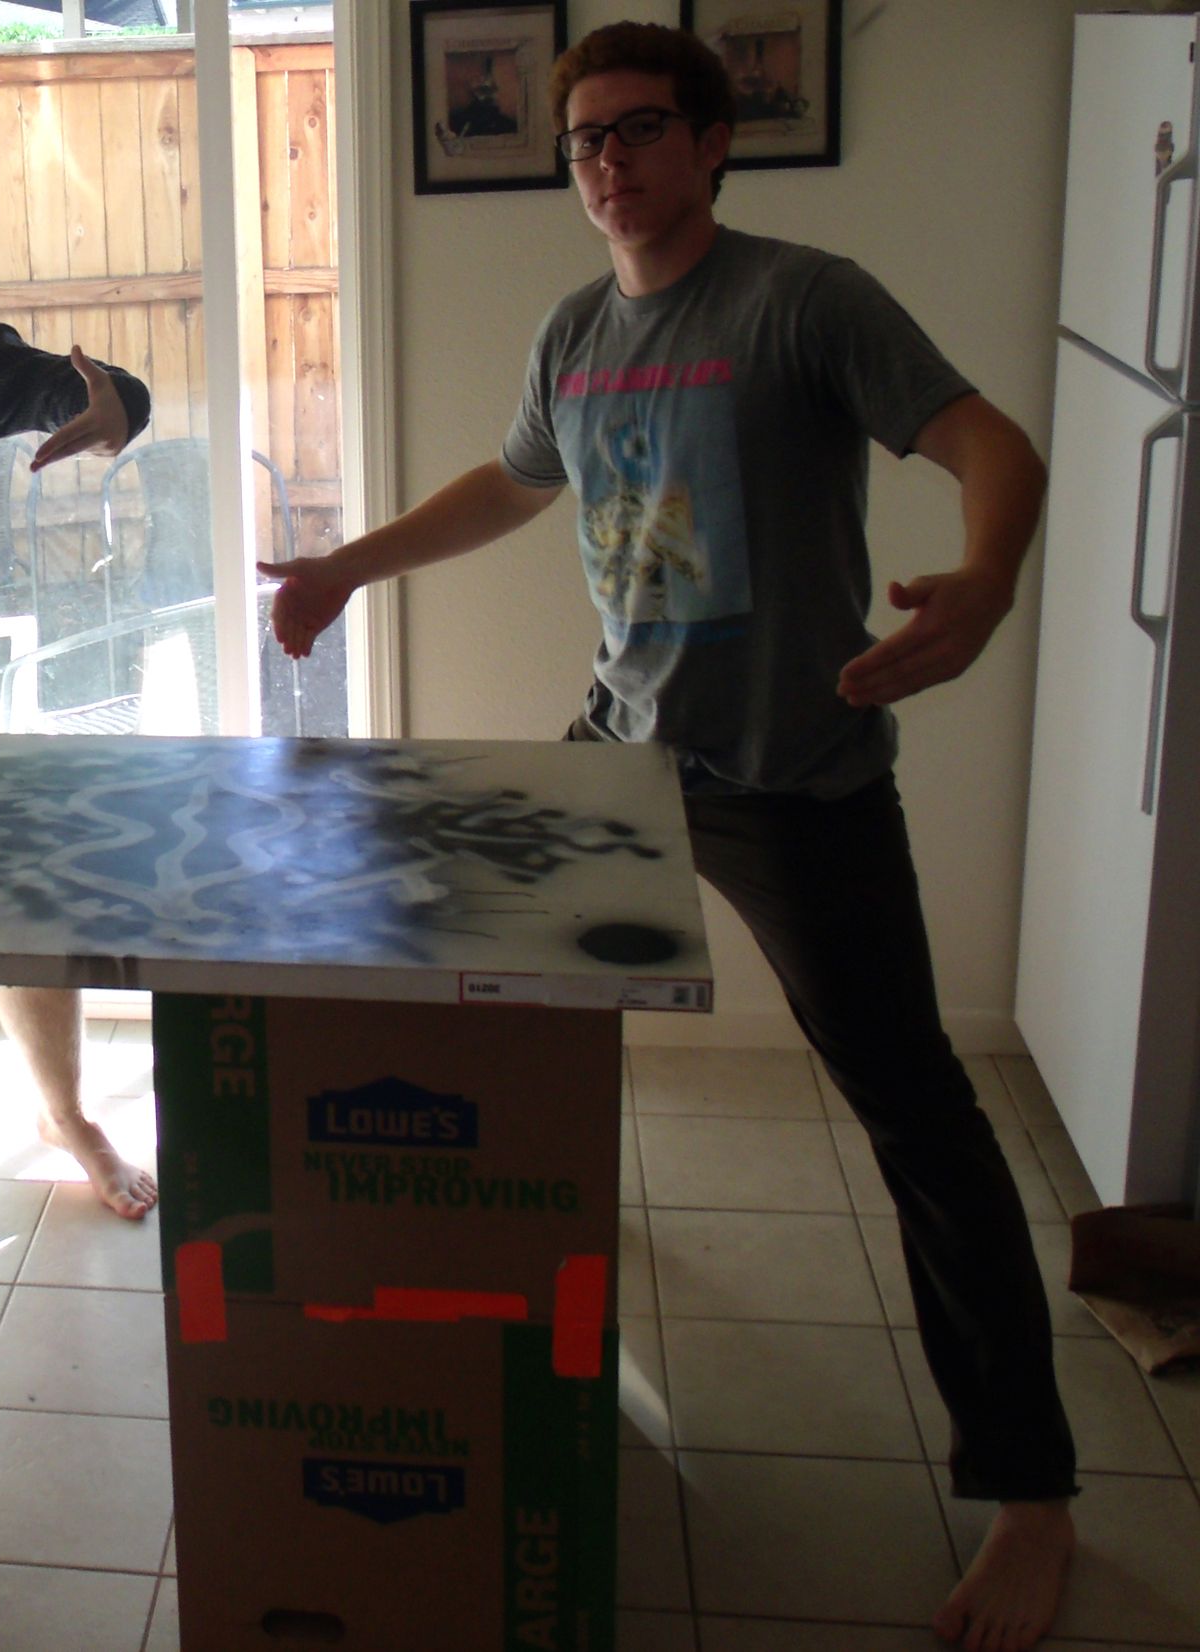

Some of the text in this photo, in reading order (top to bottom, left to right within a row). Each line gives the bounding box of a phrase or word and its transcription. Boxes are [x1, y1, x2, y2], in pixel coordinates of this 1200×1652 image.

[209, 996, 256, 1099] RGE
[326, 1101, 461, 1140] LOWE'S
[303, 1151, 472, 1177] NEVER STOP
[327, 1166, 579, 1211] IMPROVING
[207, 1396, 447, 1441] IMPROVING
[308, 1430, 470, 1457] NEVER STOP
[319, 1464, 449, 1504] LOWE'S
[513, 1506, 560, 1652] ARGE
